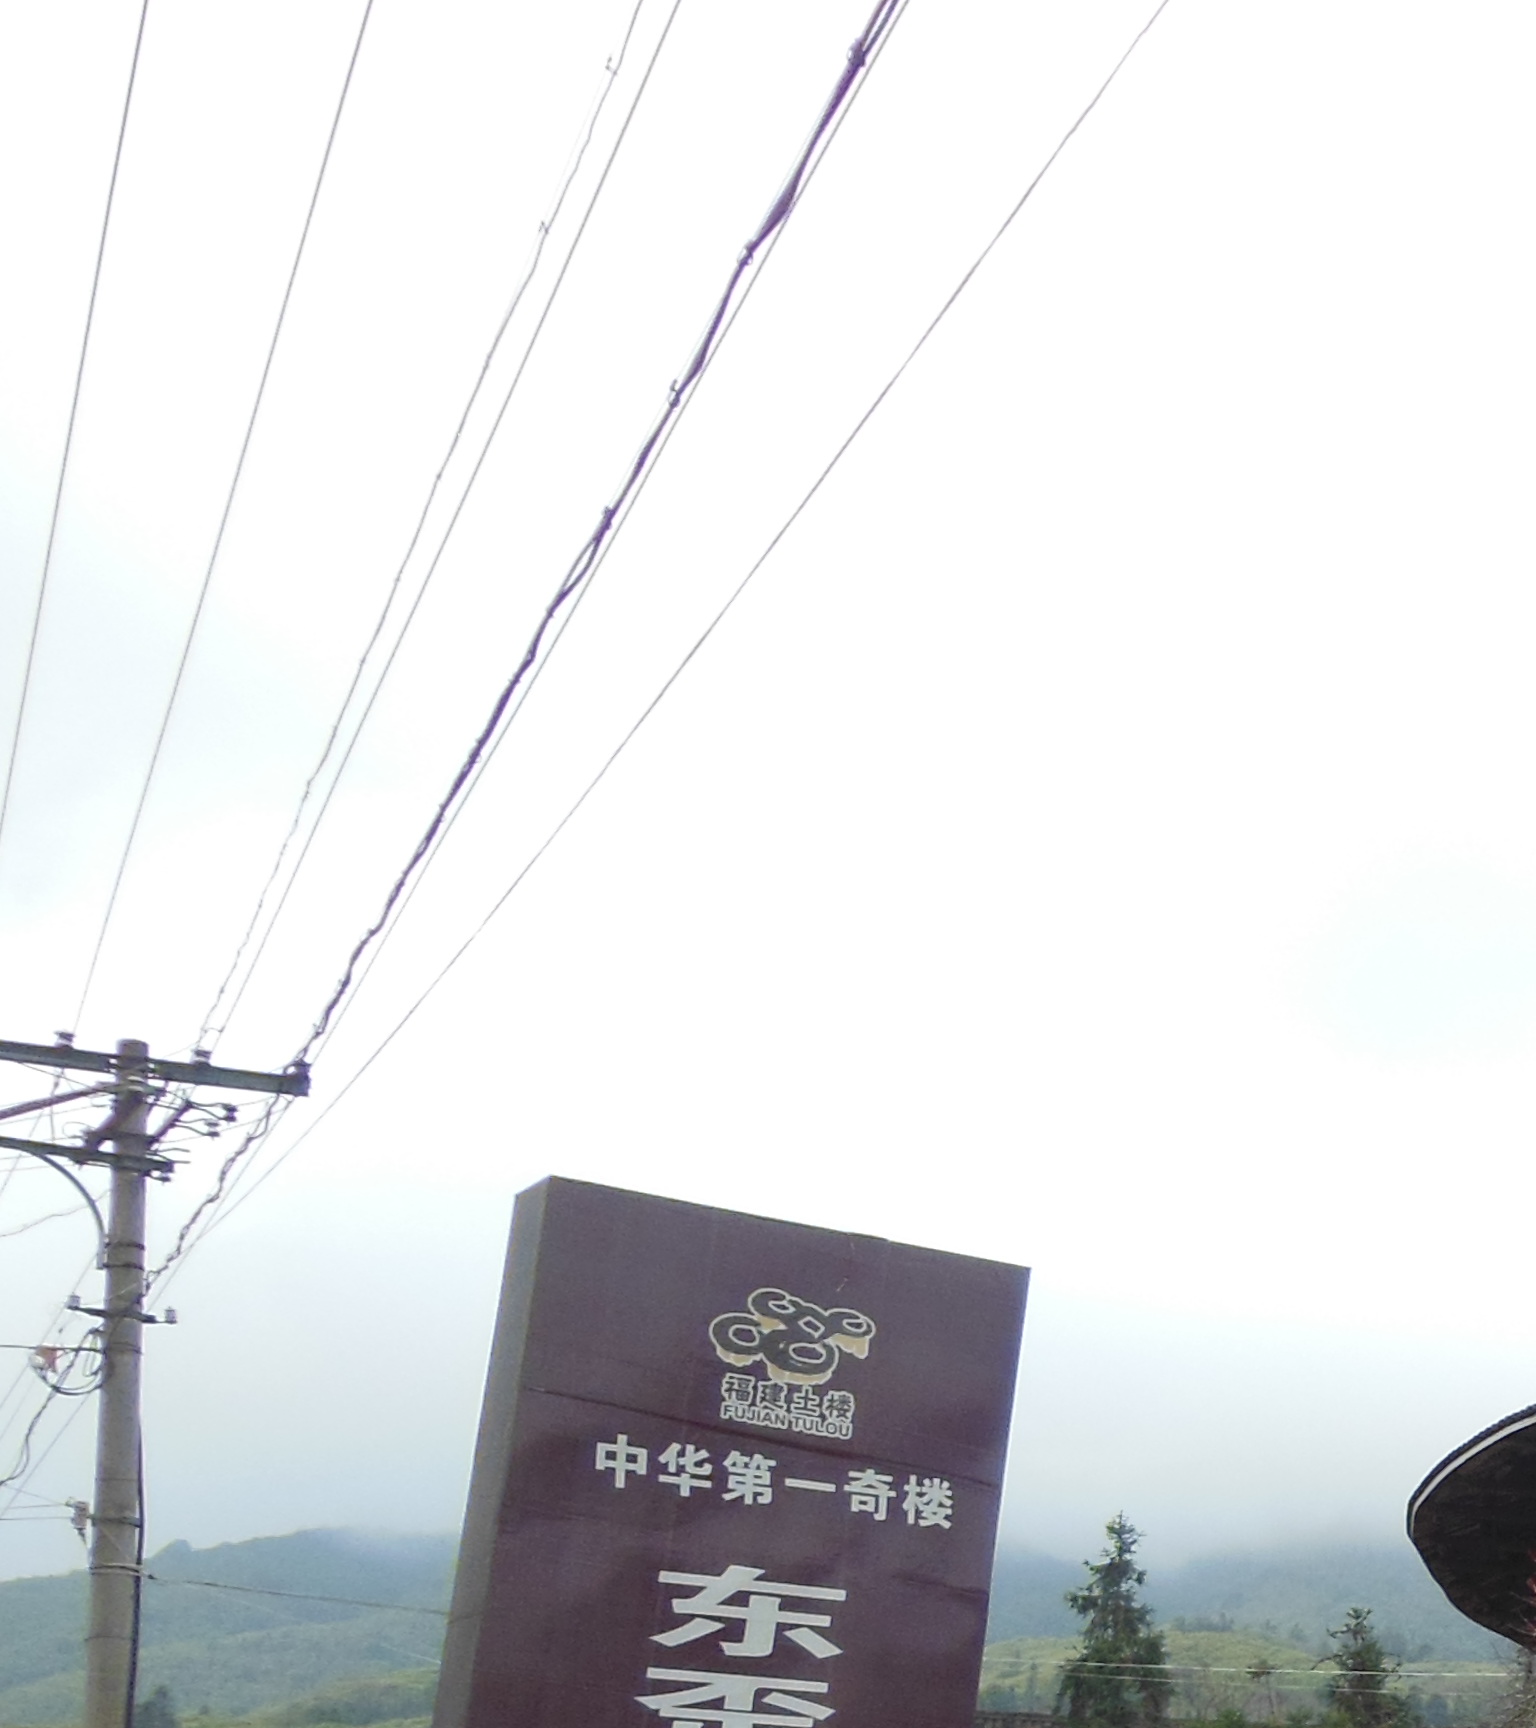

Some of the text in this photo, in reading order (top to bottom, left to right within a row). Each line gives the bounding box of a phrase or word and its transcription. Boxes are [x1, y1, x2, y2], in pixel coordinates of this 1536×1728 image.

[722, 1374, 853, 1421] 福建土楼
[722, 1404, 851, 1438] FUJIAN TULOU
[595, 1434, 953, 1529] 中华第一奇楼
